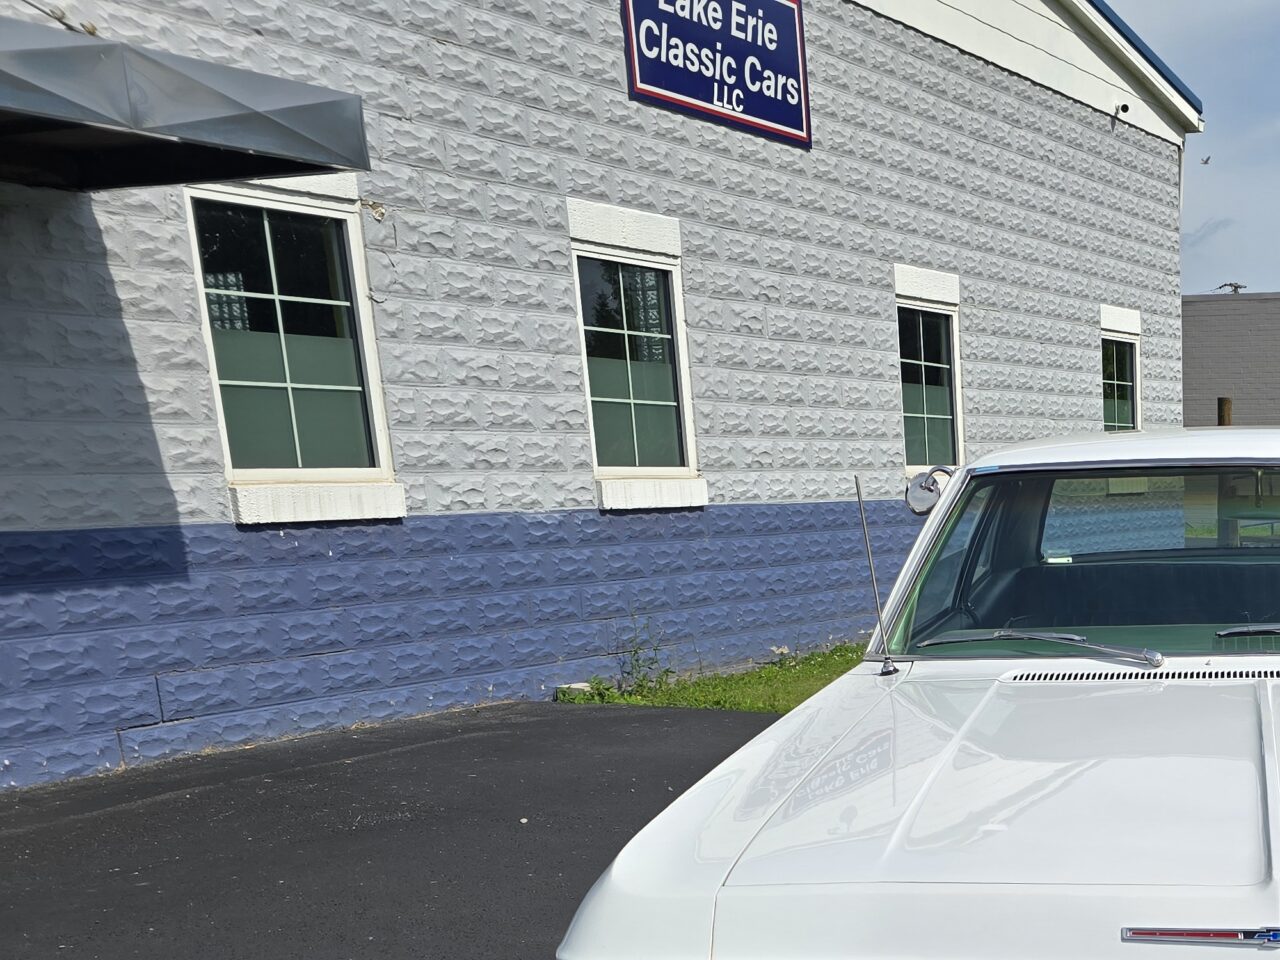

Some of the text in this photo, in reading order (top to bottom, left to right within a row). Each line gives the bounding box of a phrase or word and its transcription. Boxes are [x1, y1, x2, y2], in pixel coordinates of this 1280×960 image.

[731, 0, 778, 51] Erie
[639, 18, 799, 105] Classic Cars
[713, 82, 744, 112] LLC
